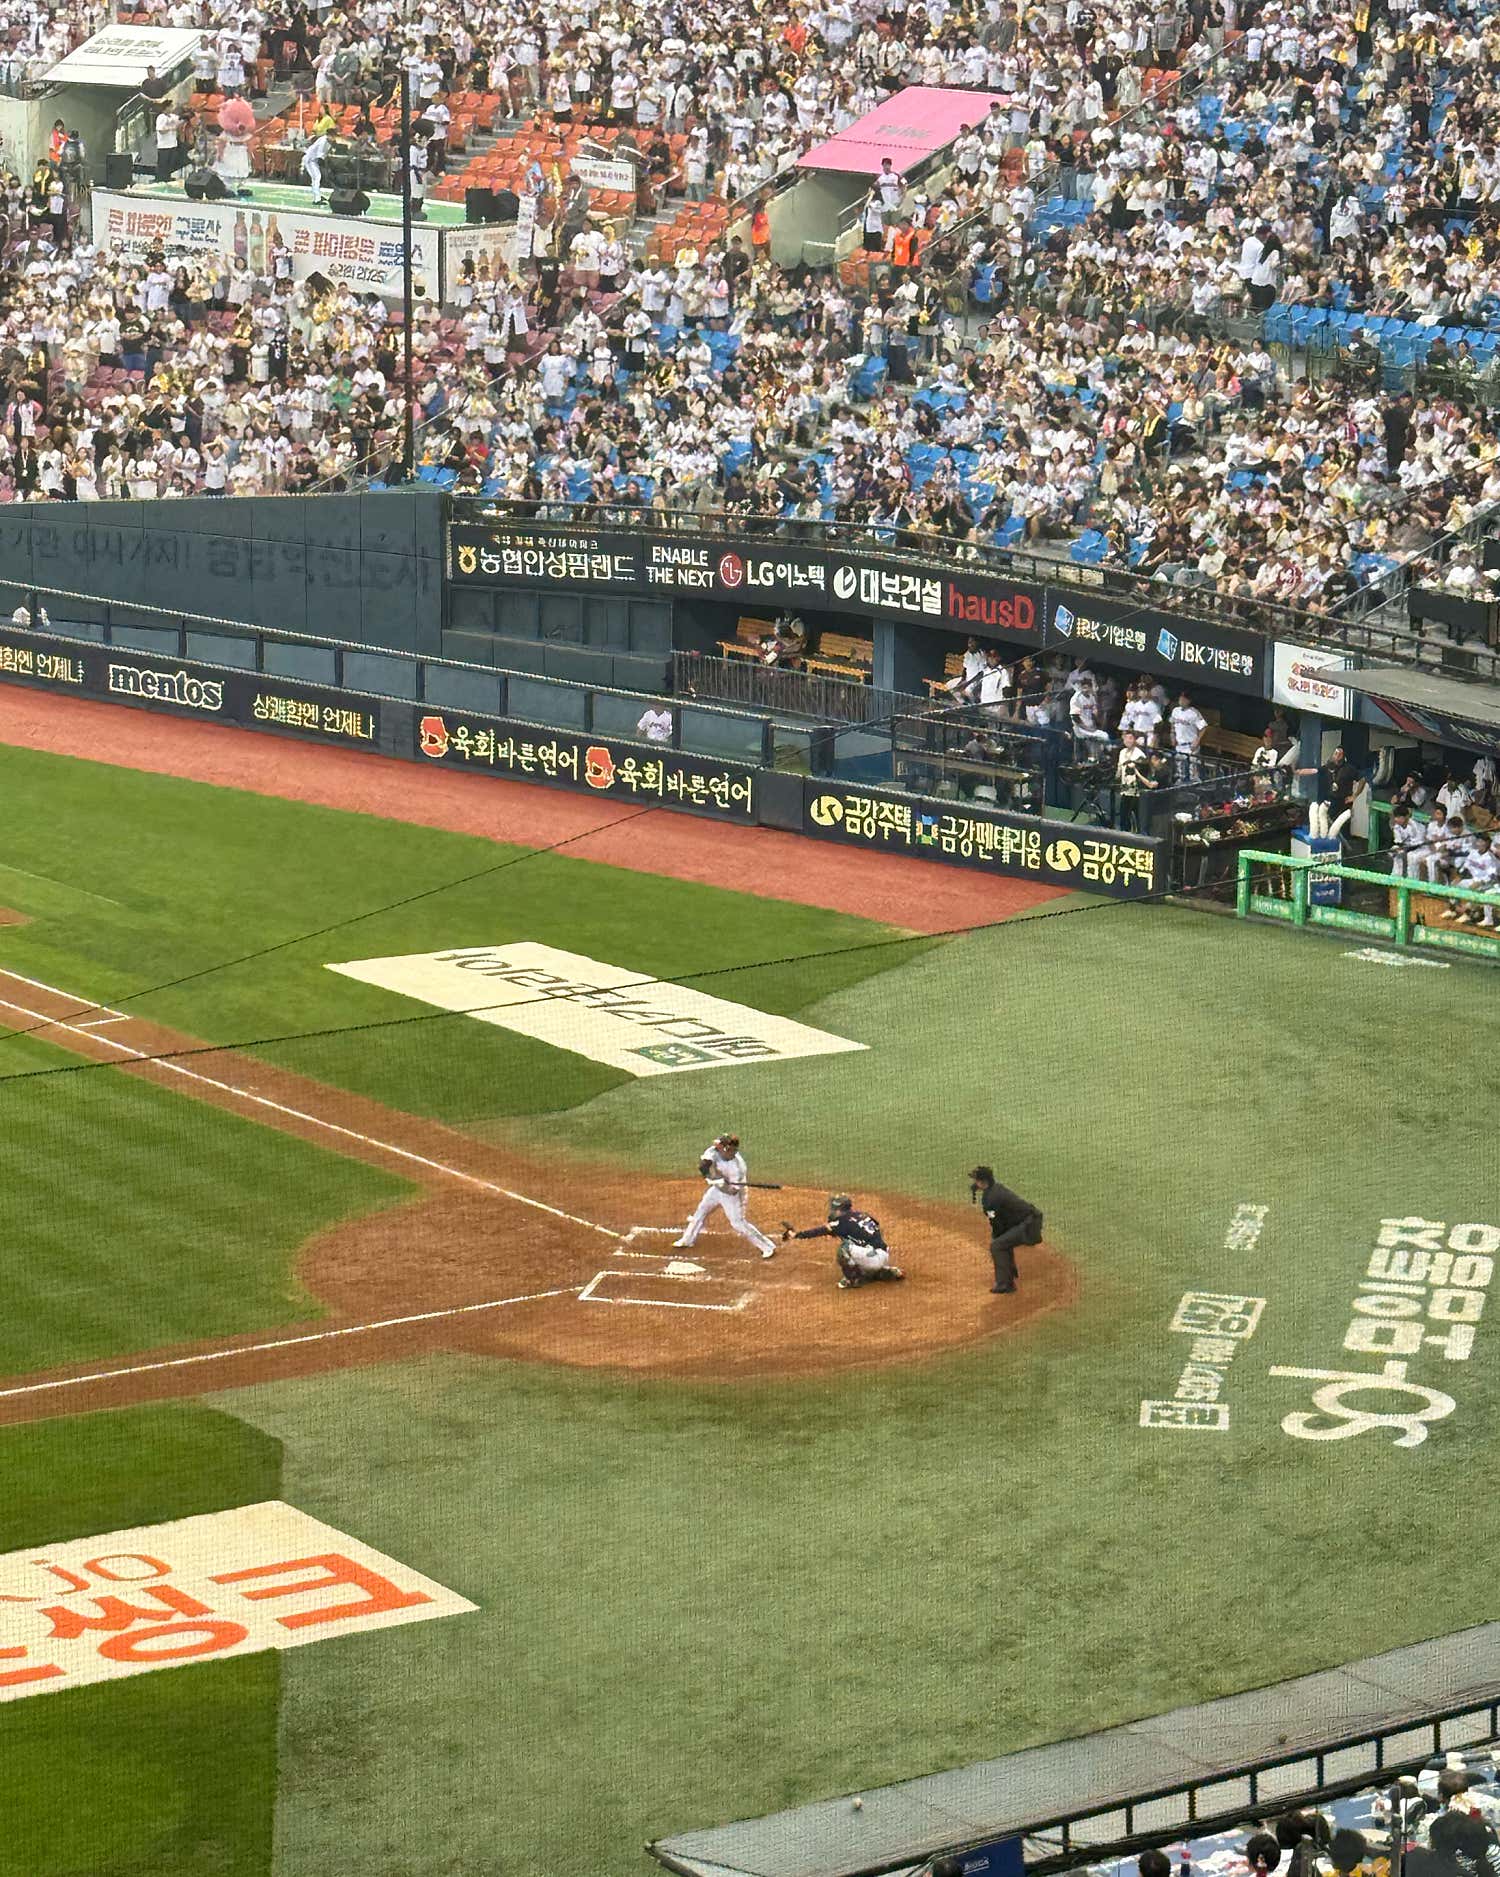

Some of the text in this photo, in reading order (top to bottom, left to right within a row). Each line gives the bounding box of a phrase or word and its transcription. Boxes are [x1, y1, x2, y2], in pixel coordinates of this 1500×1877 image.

[480, 548, 635, 581] 농협안성팜랜드
[645, 566, 715, 588] THE NEXT
[652, 546, 708, 566] ENABLE
[746, 560, 825, 591] LG이노텍
[860, 568, 942, 615] 대보건설
[949, 583, 1036, 630] hausD
[0, 646, 84, 684] 함엔 언제나
[1180, 640, 1254, 677] IBK기업은행
[108, 664, 223, 711] mentos
[322, 706, 376, 740] 언제나
[845, 795, 912, 845] 금강주택
[1083, 840, 1154, 891] 금강주택
[1269, 1360, 1456, 1448] SOL
[0, 1553, 435, 1687] 씽크
